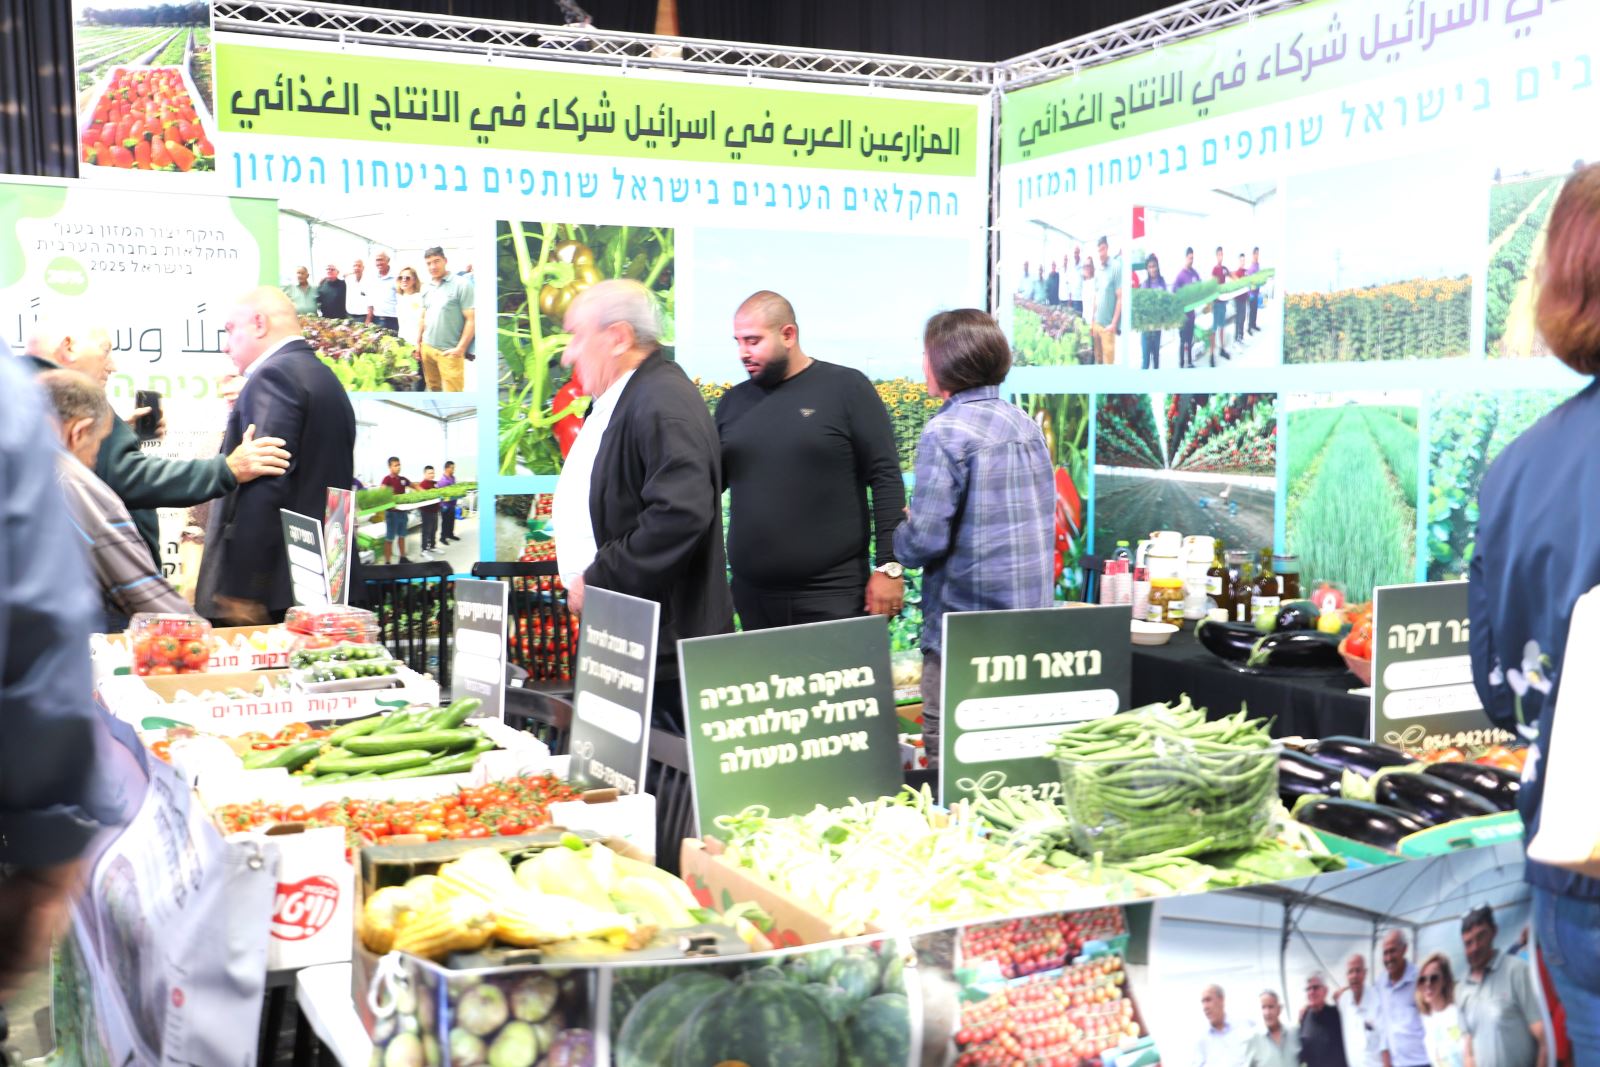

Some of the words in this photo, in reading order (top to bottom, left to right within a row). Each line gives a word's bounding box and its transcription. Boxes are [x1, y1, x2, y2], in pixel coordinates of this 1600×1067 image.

[1257, 11, 1347, 82] شركاء
[1191, 48, 1247, 117] في
[1515, 53, 1593, 103] בים
[231, 73, 359, 129] الغذائي
[370, 85, 459, 132] الانتاج
[470, 91, 526, 144] في
[537, 90, 616, 142] شركاء
[1110, 70, 1183, 130] الانتاج
[1340, 76, 1491, 139] בישראל
[625, 102, 716, 149] اسرائيل
[725, 110, 774, 160] في
[783, 119, 852, 157] العرب
[1018, 92, 1103, 157] الغذائي
[1202, 114, 1324, 167] שותפים
[861, 125, 960, 163] المزارعين
[233, 151, 326, 189] המזון
[342, 157, 468, 194] בביטחון
[483, 167, 599, 199] שותפים
[613, 166, 719, 205] בישראל
[1018, 167, 1077, 208] המזון
[1087, 144, 1188, 196] בביטחון
[733, 180, 831, 211] הערבים
[843, 183, 959, 221] החקלאים
[36, 239, 100, 253] הערבית
[54, 222, 95, 236] בענף
[100, 224, 144, 238] המזון
[186, 229, 226, 243] היקף
[91, 260, 126, 272] 2025
[106, 243, 158, 256] בחברה
[131, 260, 193, 275] בישראל
[164, 246, 239, 261] החקלאות
[1387, 621, 1442, 654] דקה
[208, 655, 239, 668] מוב
[970, 654, 1027, 683] ותד
[1032, 649, 1102, 679] נזאר
[769, 674, 806, 699] אל
[808, 665, 876, 697] באקה
[212, 701, 294, 720] מובחרים
[308, 694, 358, 714] ירקות
[811, 697, 880, 725] גידולי
[700, 707, 809, 743] קולוראבי
[719, 742, 799, 774] מעולה
[800, 730, 870, 761] איכות
